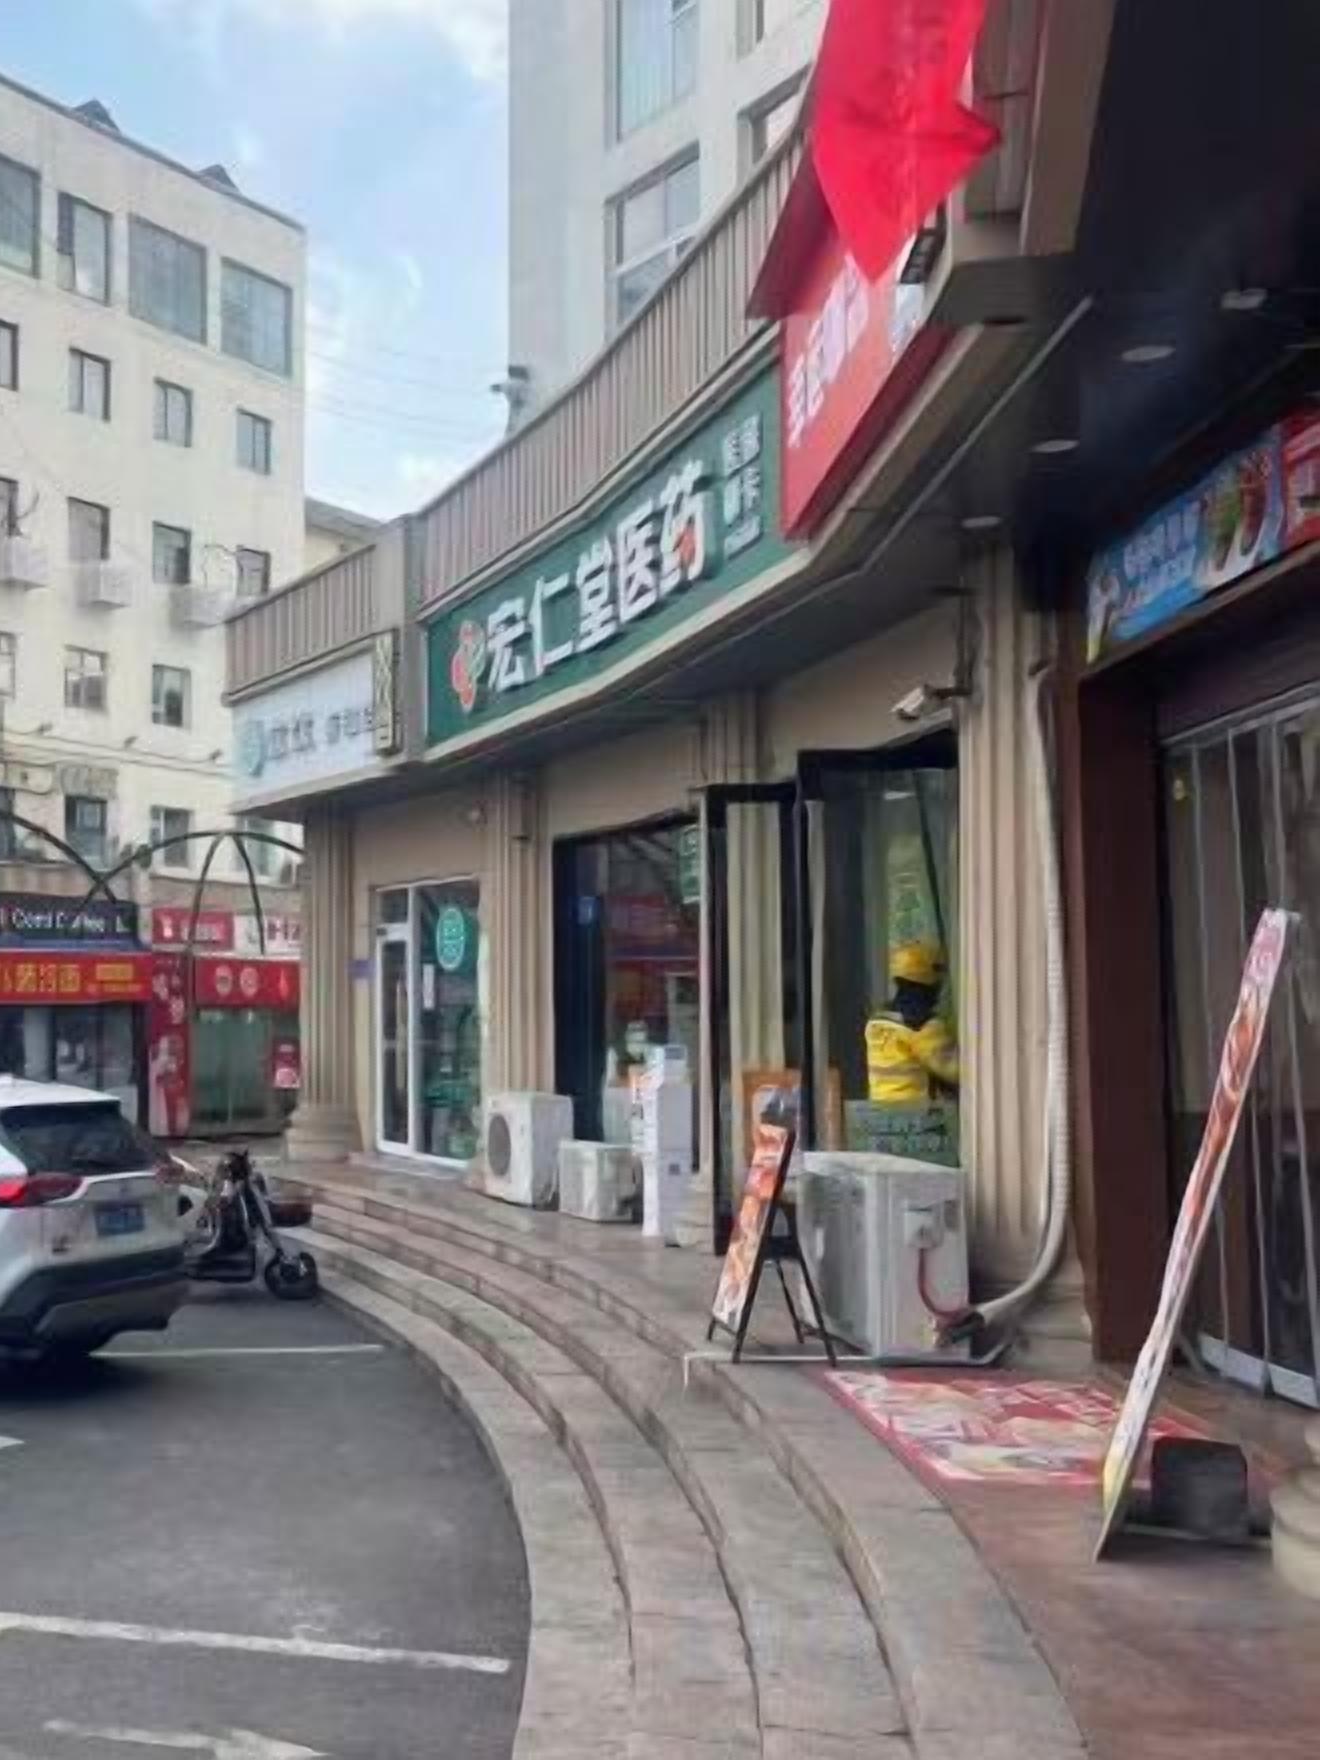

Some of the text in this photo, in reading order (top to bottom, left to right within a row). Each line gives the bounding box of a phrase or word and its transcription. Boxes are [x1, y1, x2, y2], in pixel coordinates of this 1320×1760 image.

[487, 459, 704, 693] 宏仁堂医药
